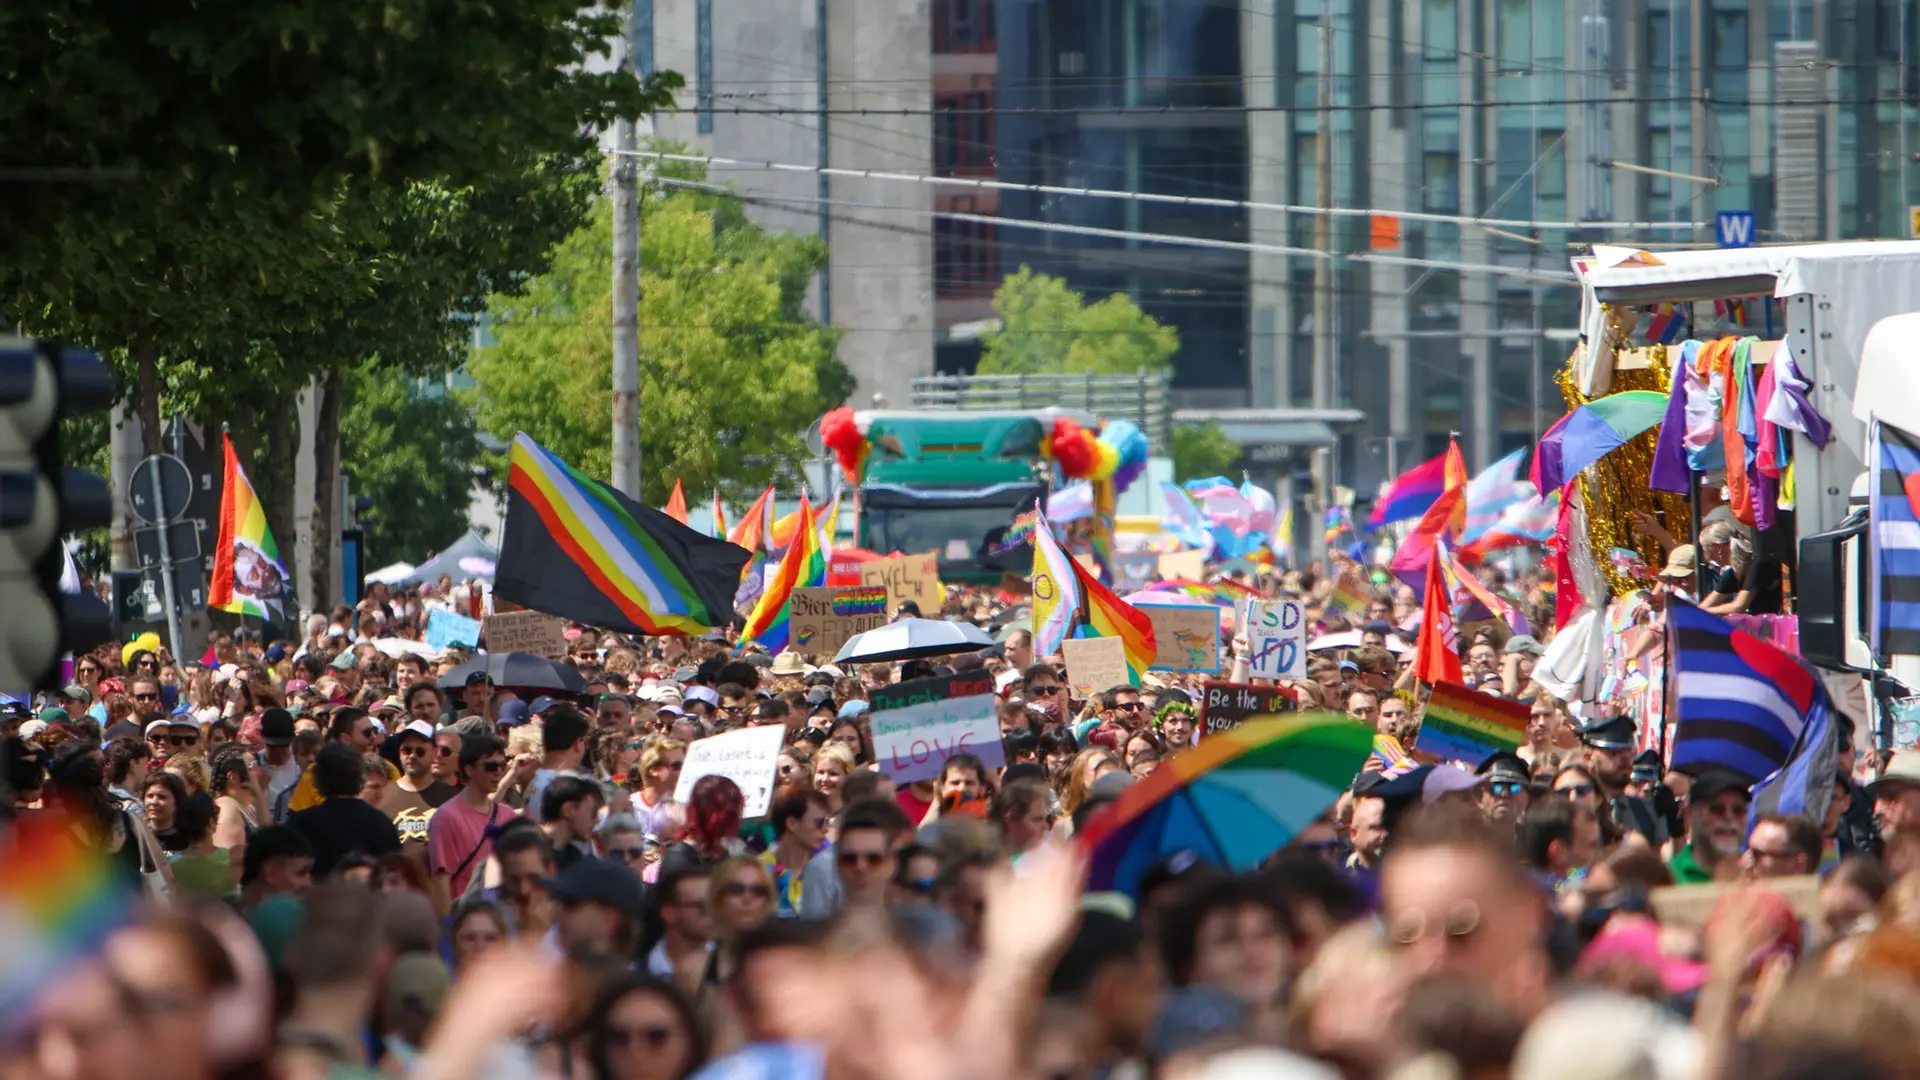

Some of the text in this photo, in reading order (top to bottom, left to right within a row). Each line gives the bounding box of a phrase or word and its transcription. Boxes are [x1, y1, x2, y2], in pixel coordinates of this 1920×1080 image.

[1720, 215, 1750, 244] W
[791, 594, 831, 616] Bier
[1248, 602, 1300, 630] SD
[875, 694, 906, 711] The
[908, 687, 942, 707] only
[1209, 687, 1230, 709] Be
[1236, 688, 1258, 710] the
[876, 706, 990, 736] thing is to just
[1207, 715, 1231, 736] you
[892, 731, 976, 772] LOVE
